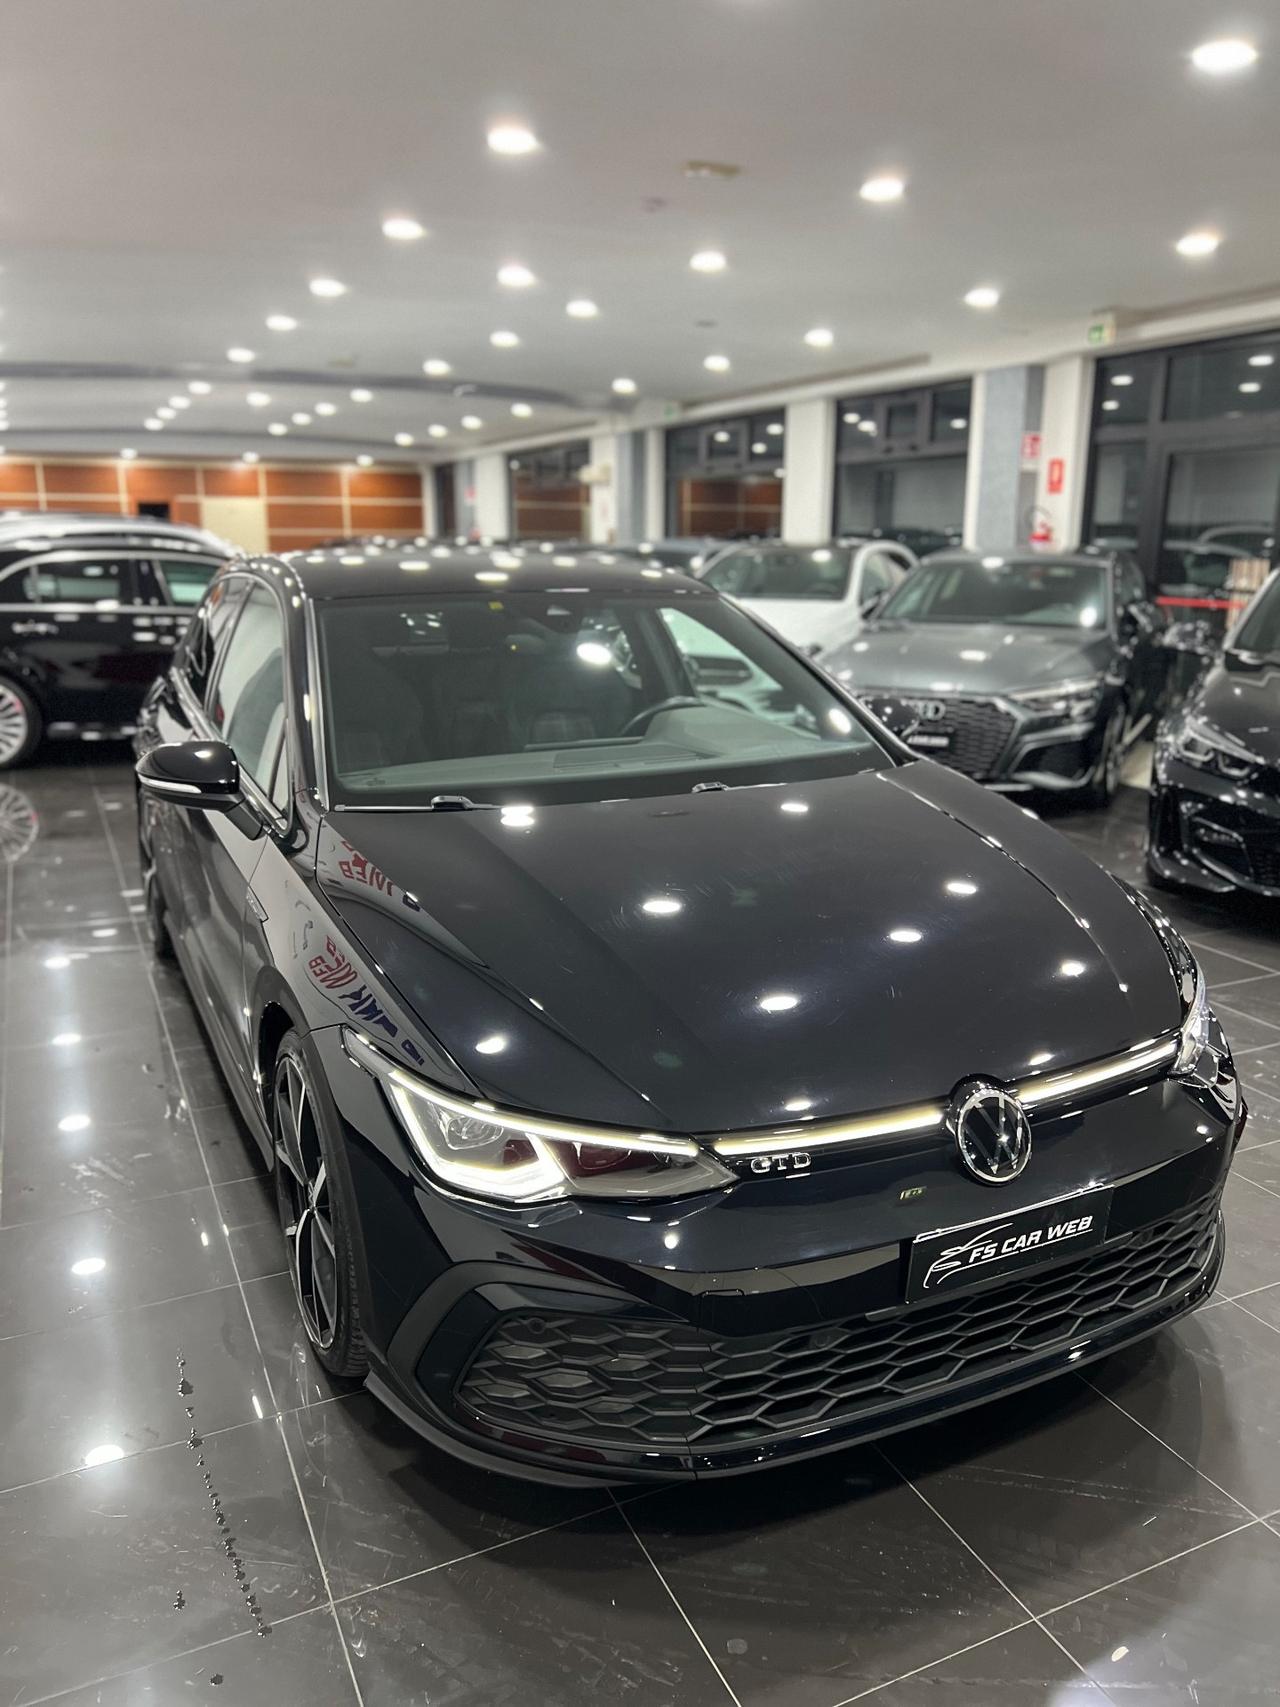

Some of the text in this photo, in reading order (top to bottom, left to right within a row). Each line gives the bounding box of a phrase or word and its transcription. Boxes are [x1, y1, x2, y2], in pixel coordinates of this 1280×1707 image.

[750, 1152, 811, 1173] GTD
[968, 1215, 1094, 1264] FS CAR WEB
